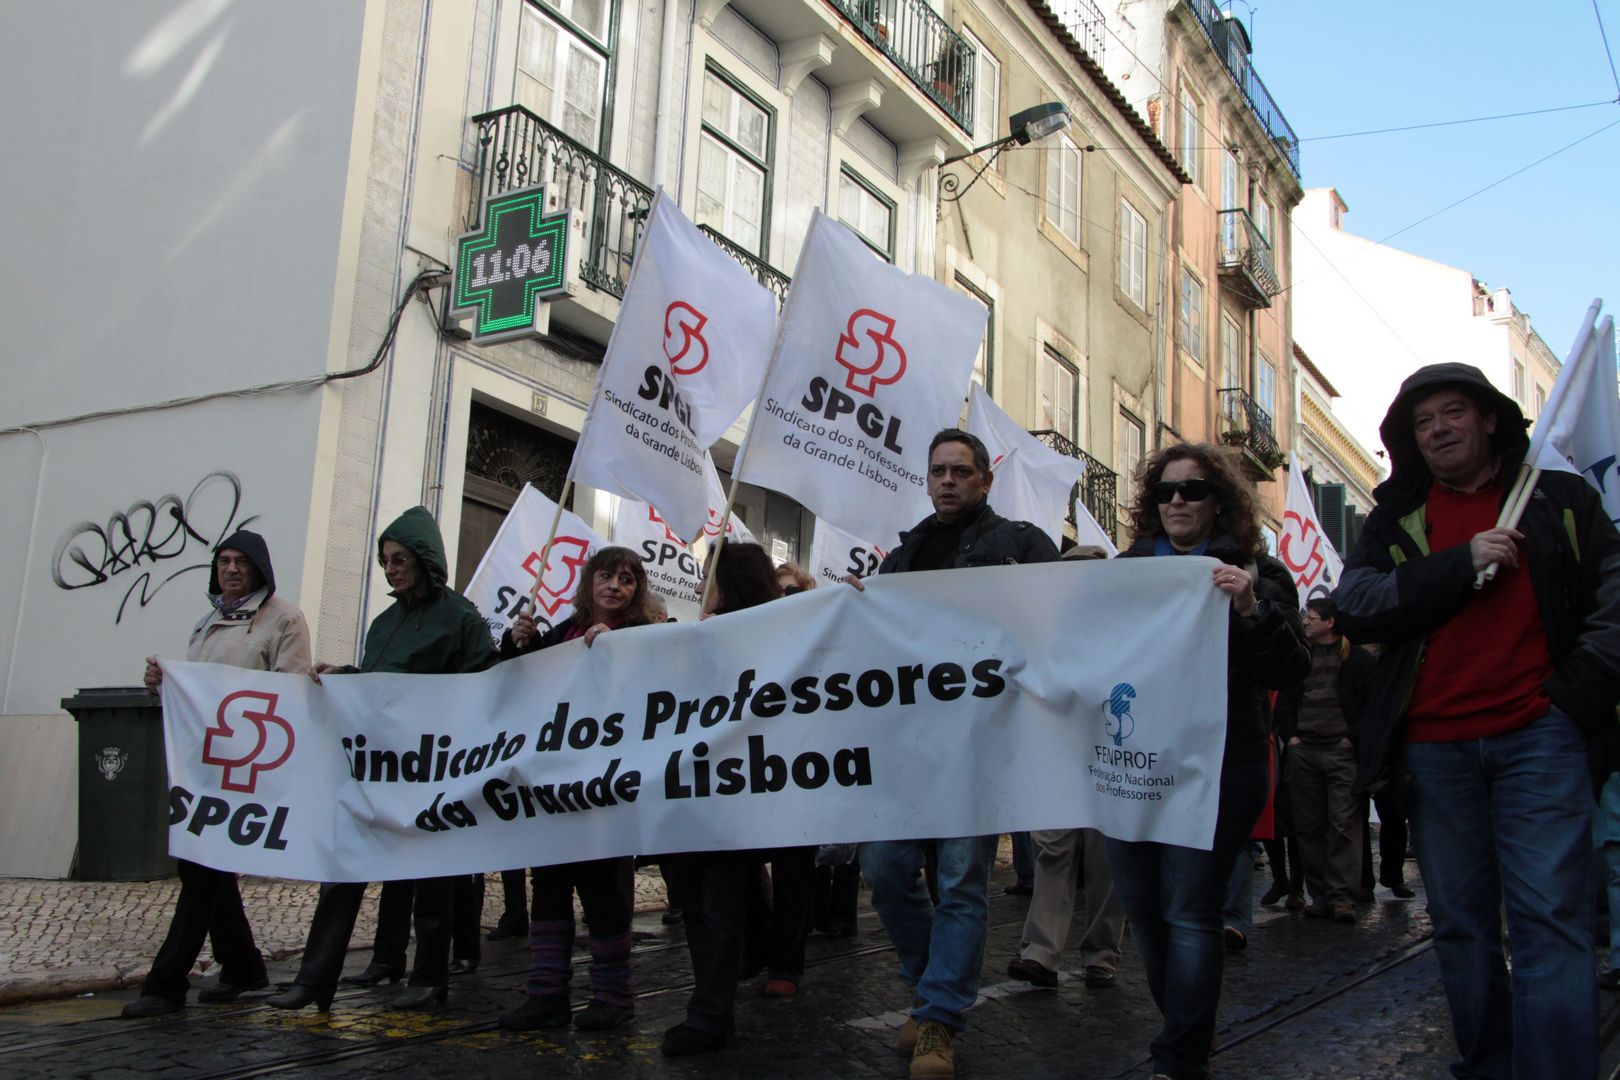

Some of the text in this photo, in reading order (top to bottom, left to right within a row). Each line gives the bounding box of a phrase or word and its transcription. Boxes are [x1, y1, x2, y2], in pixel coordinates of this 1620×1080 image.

[472, 239, 550, 288] 11:06
[604, 389, 659, 428] Sindicato
[660, 420, 680, 439] dos
[637, 365, 697, 437] SPGL
[801, 376, 903, 455] SPGL
[625, 423, 640, 439] da
[642, 432, 680, 461] Grande
[764, 398, 826, 436] Sindicato
[828, 429, 853, 448] dos
[857, 440, 925, 487] Professores
[783, 433, 898, 492] da Grande Lisboa
[660, 572, 677, 584] dos
[535, 702, 625, 751] dos
[642, 658, 1006, 741] Professores
[415, 734, 873, 832] da Grande Lisboa
[1088, 765, 1174, 787] Federação Nacional
[1095, 745, 1158, 770] FENPROF
[1096, 781, 1162, 800] dos Professores
[169, 785, 290, 851] SPGL
